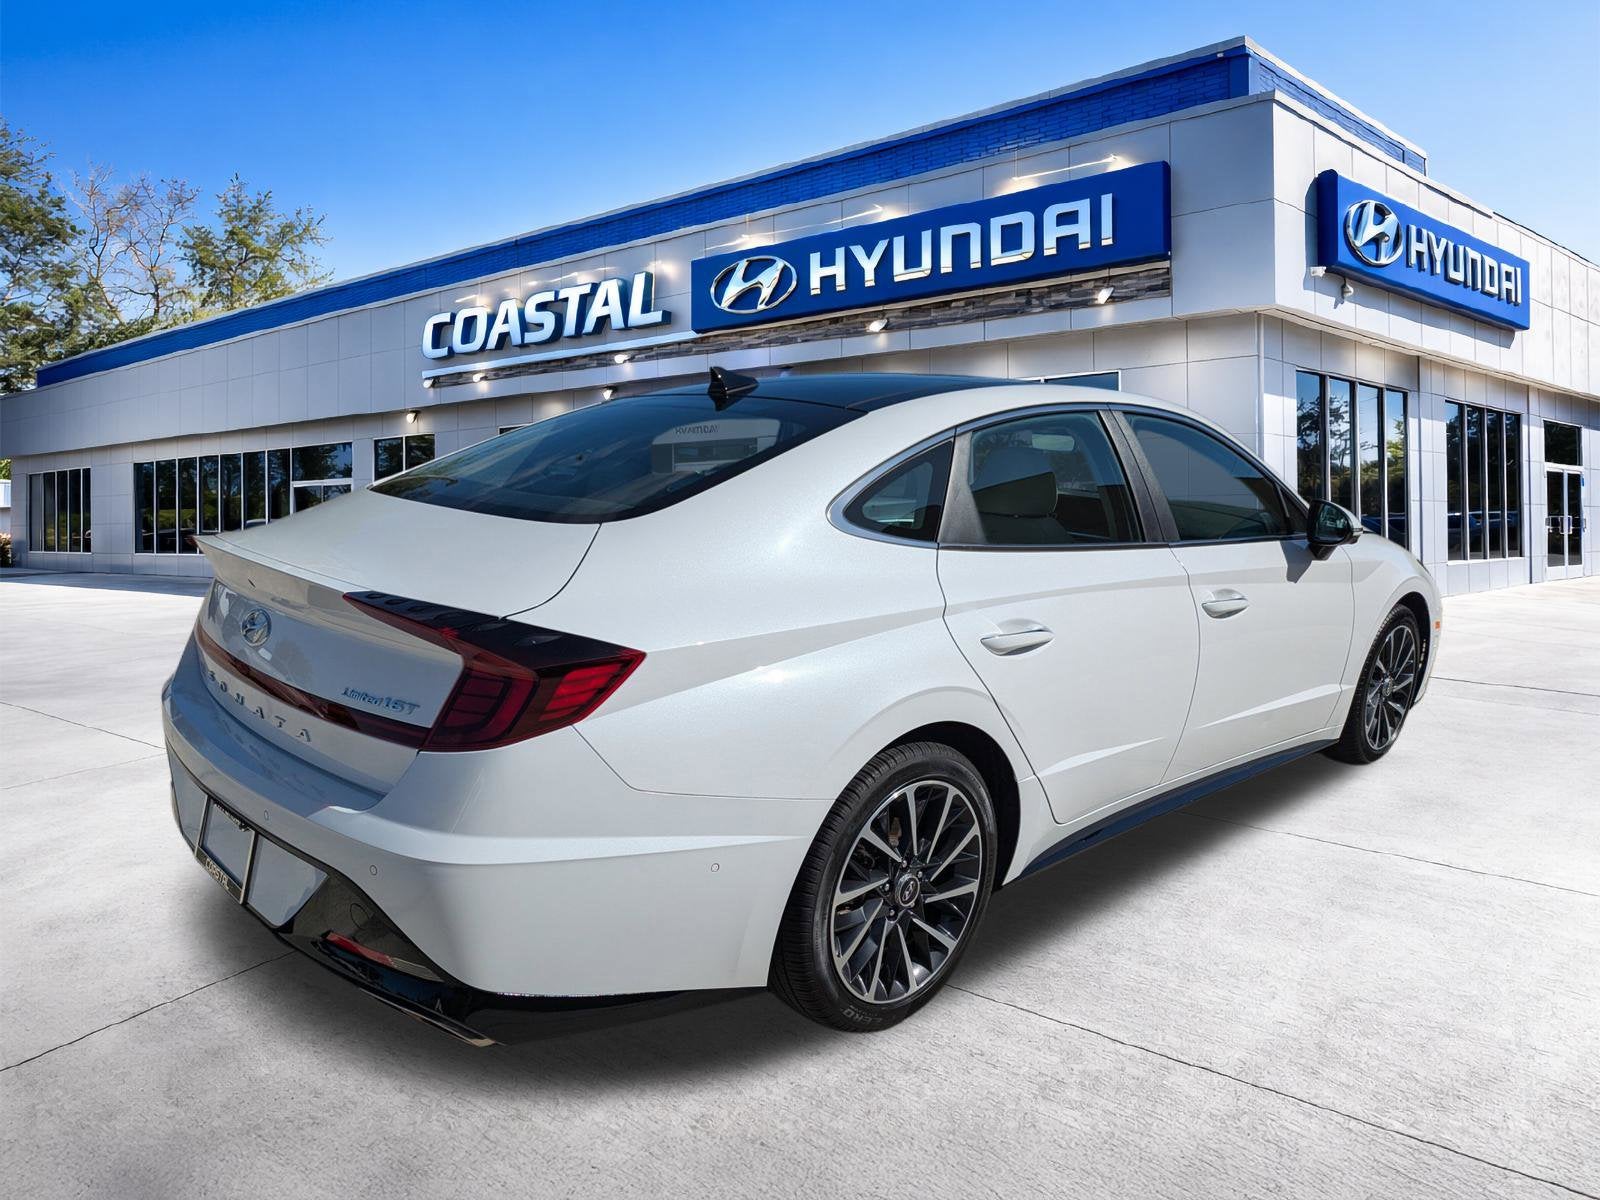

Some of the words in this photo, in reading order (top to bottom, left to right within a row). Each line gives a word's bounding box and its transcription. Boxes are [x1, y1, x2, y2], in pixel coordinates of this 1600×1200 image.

[810, 193, 1114, 296] HYUNDAI
[1406, 224, 1522, 306] HYUNDAI
[422, 271, 668, 359] COASTAL
